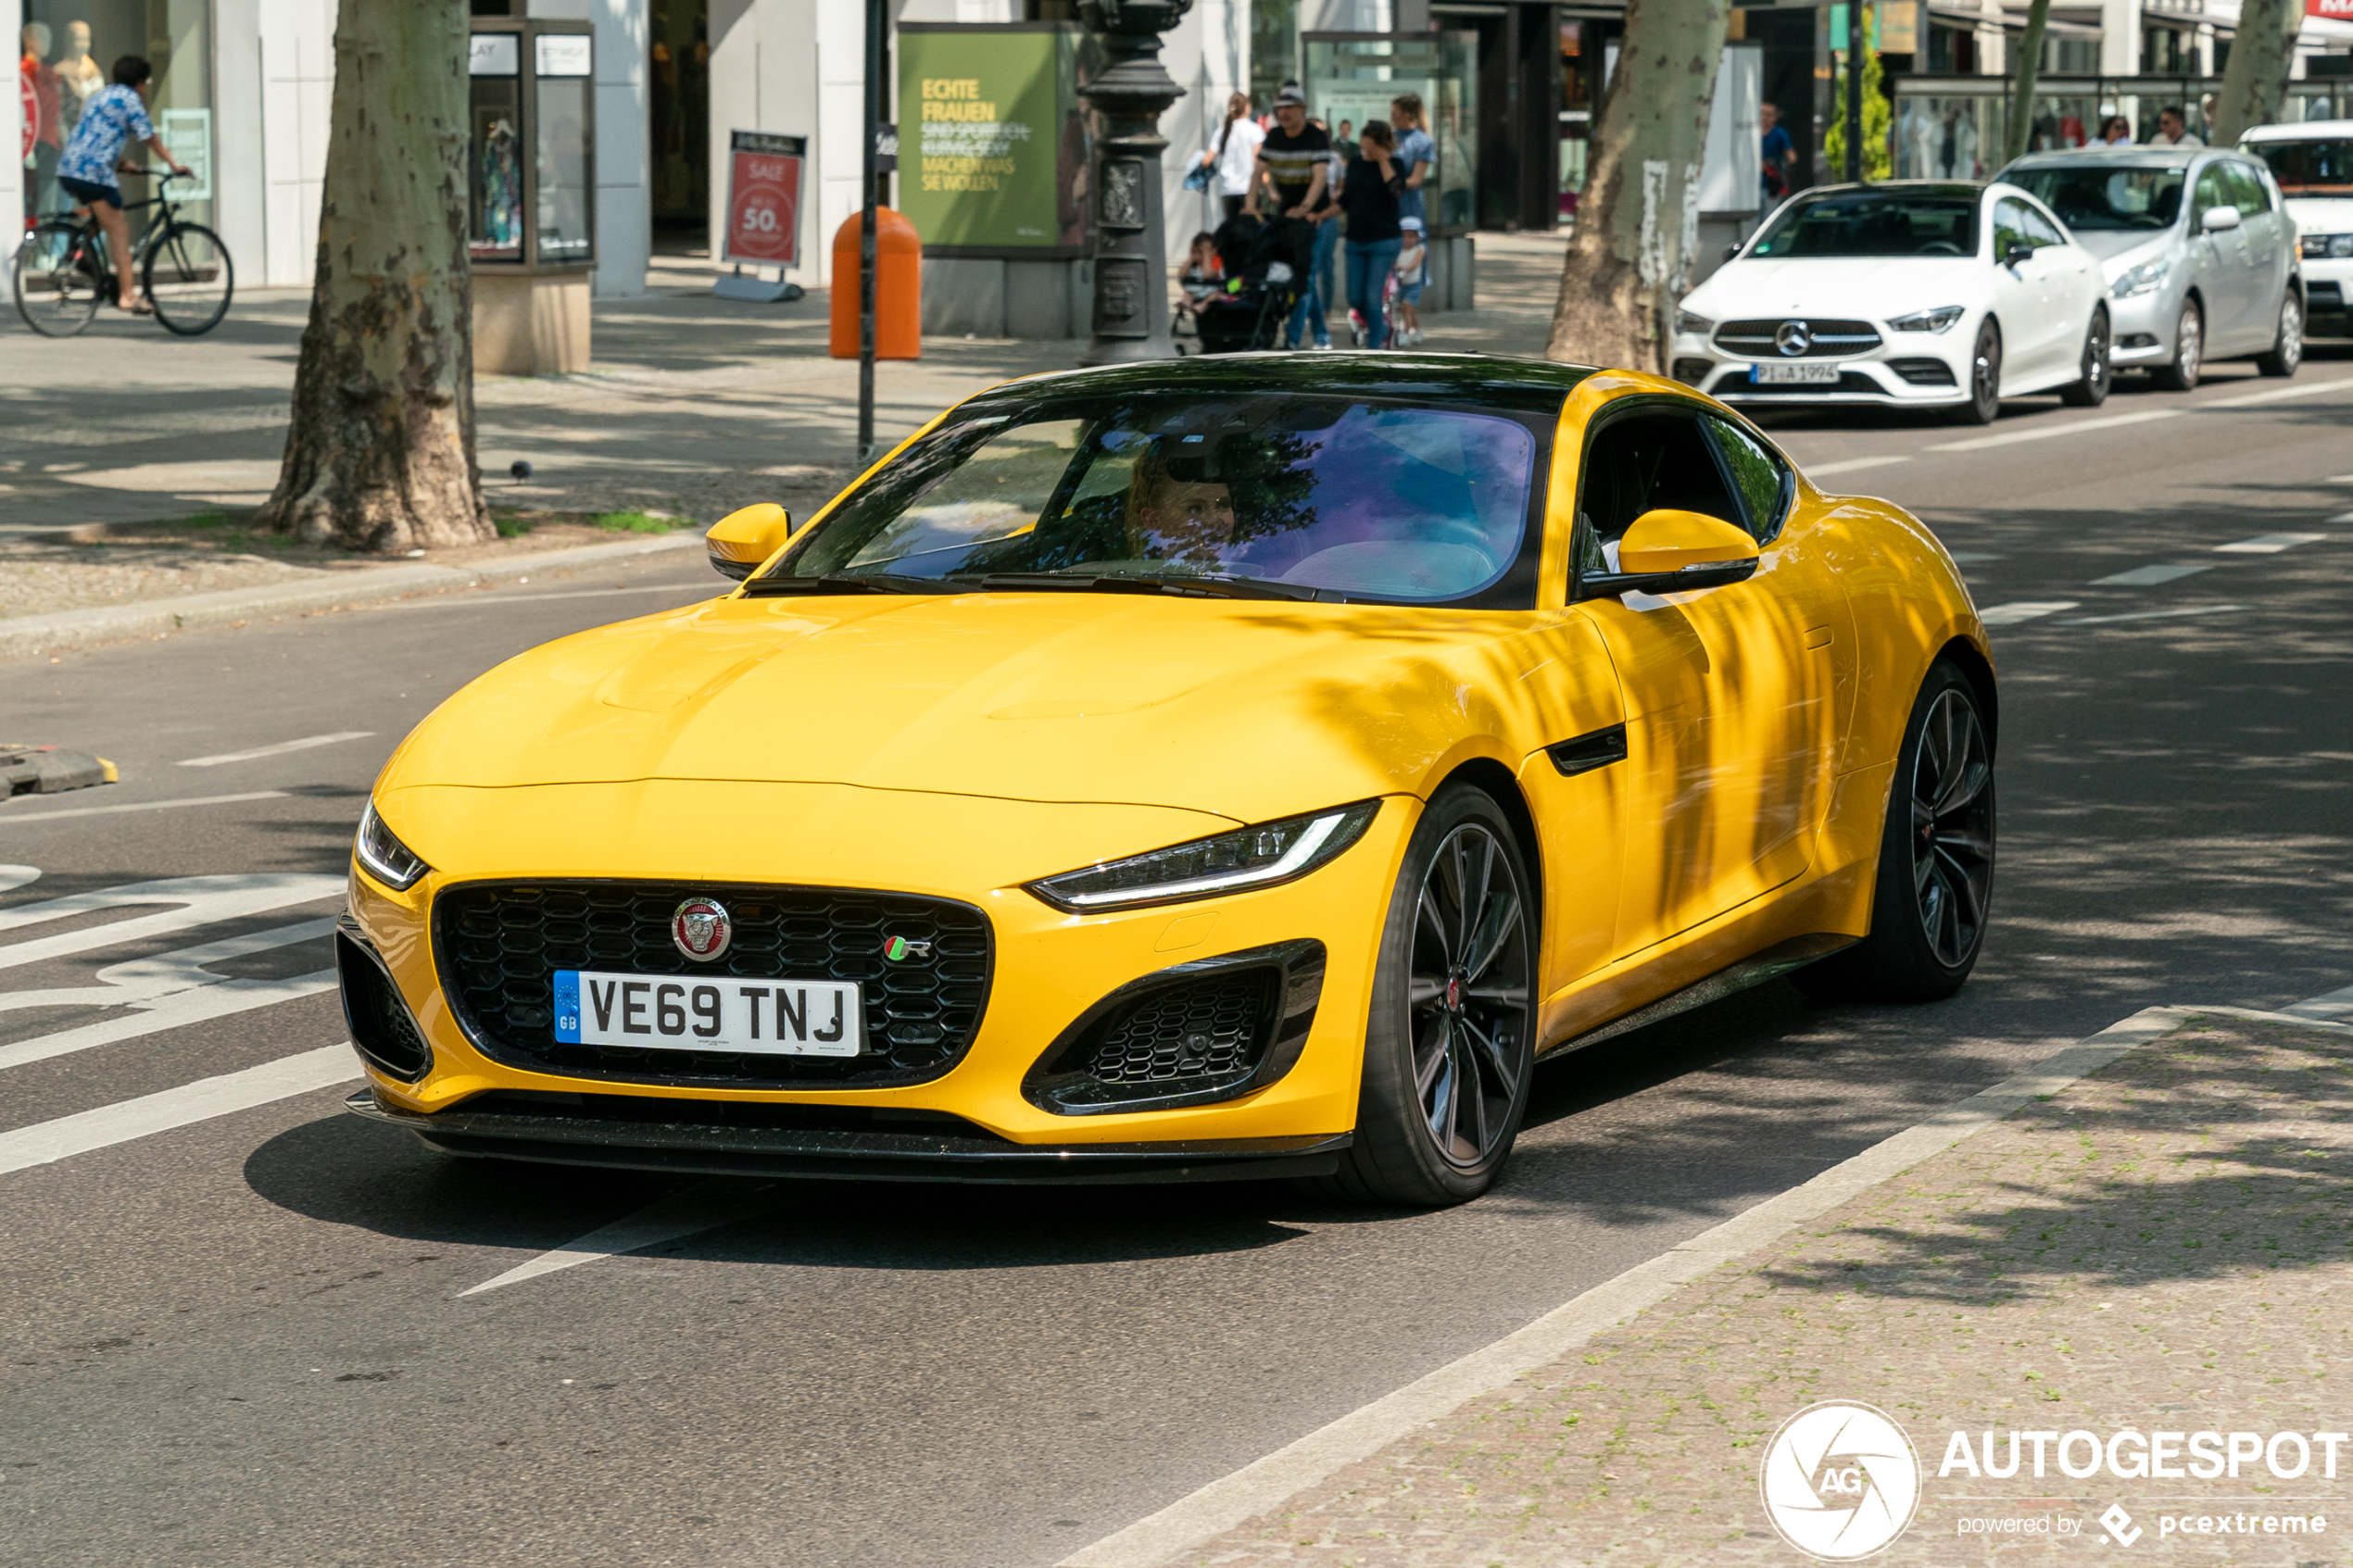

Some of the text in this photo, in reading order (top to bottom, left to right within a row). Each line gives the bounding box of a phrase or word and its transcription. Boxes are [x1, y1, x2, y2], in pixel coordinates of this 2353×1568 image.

[922, 79, 980, 100] ECHTE
[922, 102, 996, 122] FRAUEN
[748, 161, 785, 182] SALE
[922, 157, 1016, 174] MACHEN WAS
[922, 174, 1000, 191] SIE WOLLEN
[1786, 367, 1795, 379] A
[1800, 366, 1835, 381] 1994
[588, 979, 844, 1043] VE69 TNJ
[560, 1015, 577, 1030] GB
